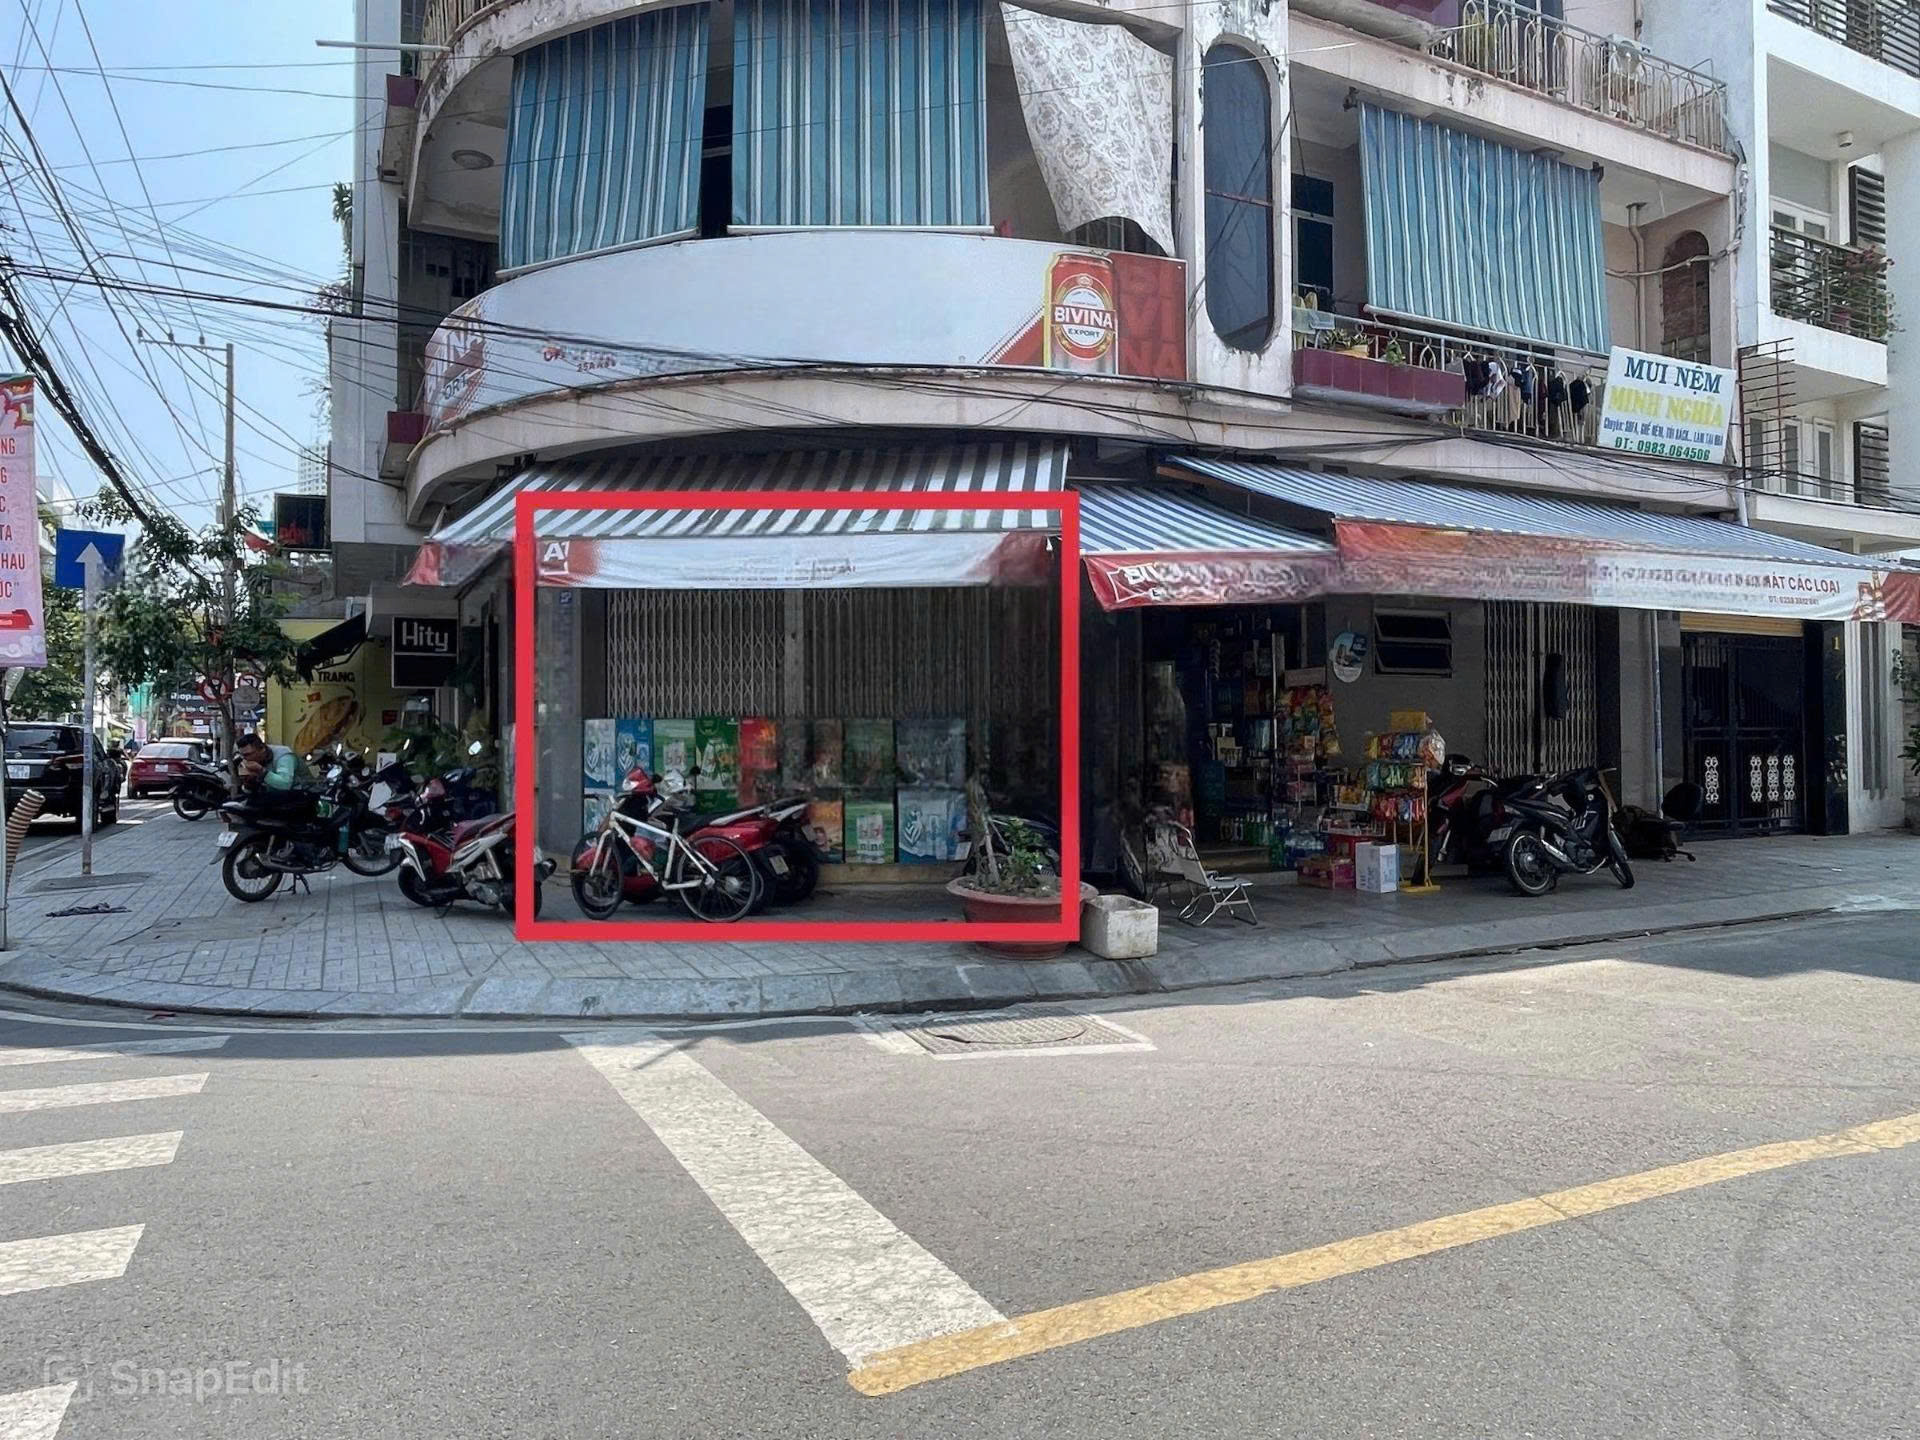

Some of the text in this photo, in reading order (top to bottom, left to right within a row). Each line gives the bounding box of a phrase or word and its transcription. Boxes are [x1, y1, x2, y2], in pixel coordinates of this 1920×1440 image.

[1054, 306, 1113, 329] BIVINA
[1068, 328, 1100, 338] EXPORT
[1625, 356, 1722, 395] MUI NỆM
[1788, 573, 1813, 592] CÁC
[1814, 578, 1841, 597] LOẠI
[402, 620, 449, 652] Hity
[318, 671, 356, 684] TRANG
